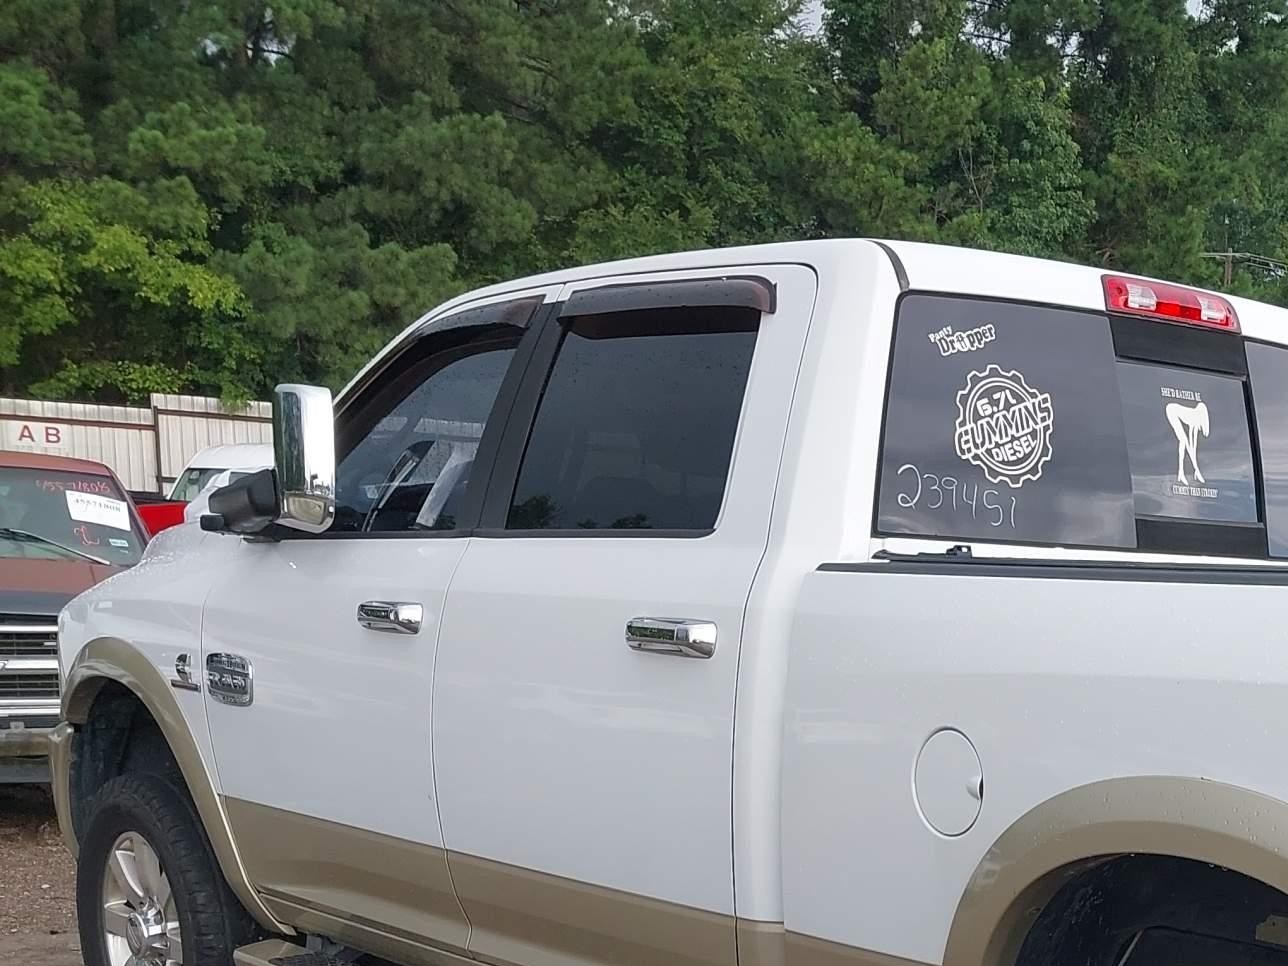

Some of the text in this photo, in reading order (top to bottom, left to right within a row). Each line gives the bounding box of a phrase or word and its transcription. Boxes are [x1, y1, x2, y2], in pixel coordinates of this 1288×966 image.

[18, 424, 61, 444] A B
[955, 392, 1053, 459] CUMMINS
[991, 434, 1037, 462] DIESEL
[897, 464, 1016, 529] 239451
